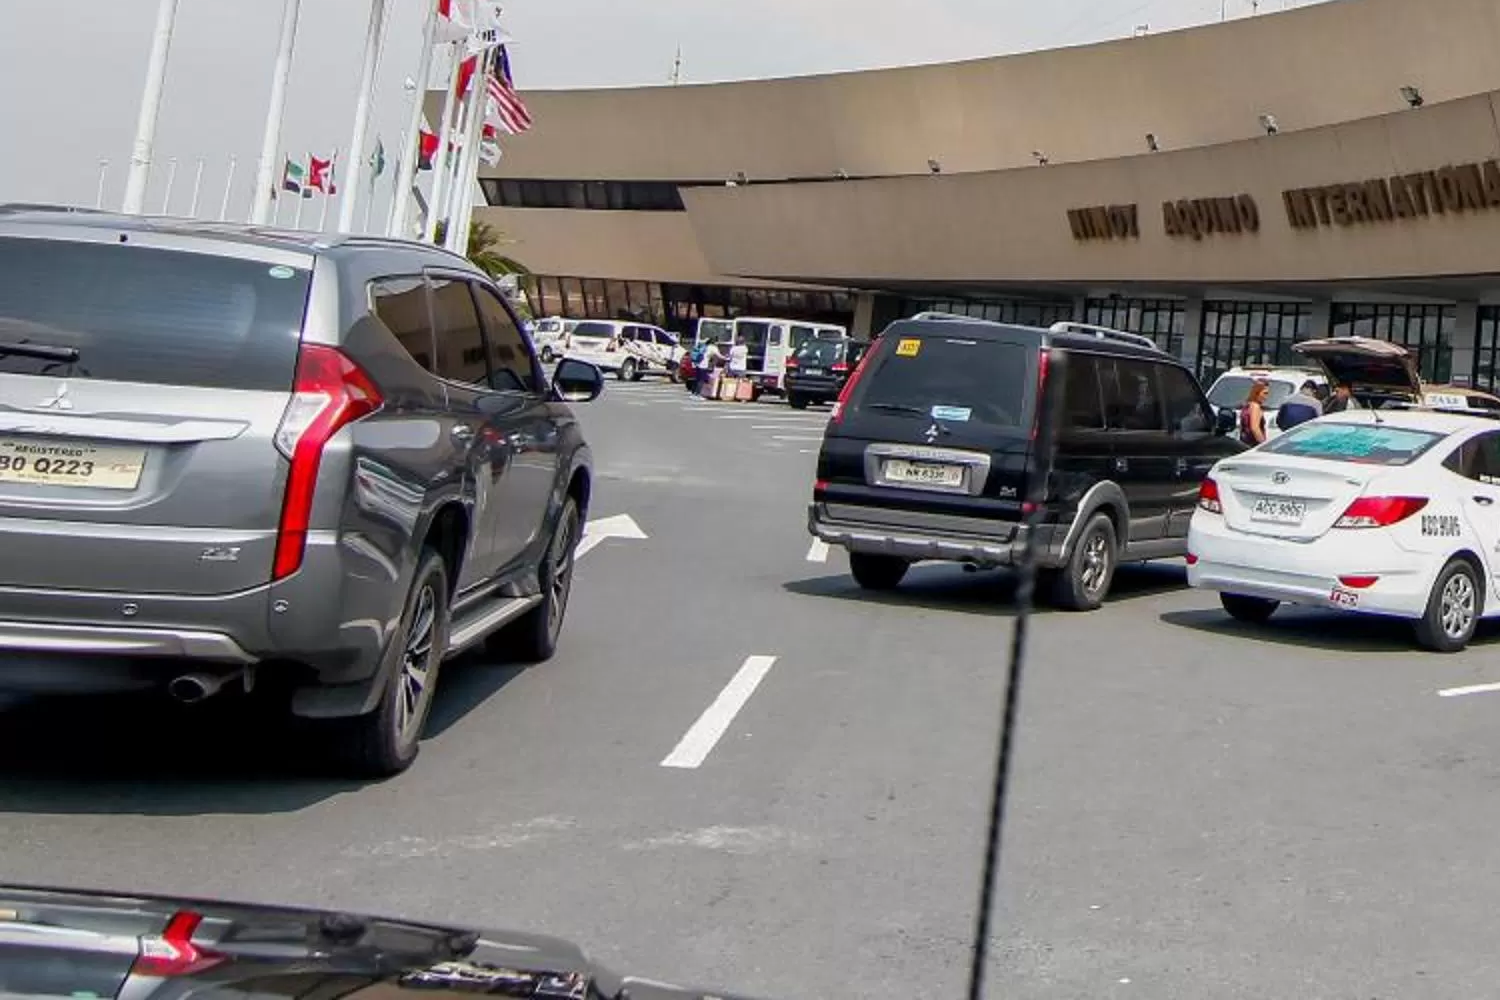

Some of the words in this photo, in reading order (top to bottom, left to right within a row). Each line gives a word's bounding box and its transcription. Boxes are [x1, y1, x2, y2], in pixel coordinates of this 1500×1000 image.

[1067, 203, 1139, 240] NINOY
[1162, 194, 1260, 241] AQUINO
[14, 445, 83, 457] REGISTERED
[33, 457, 94, 476] Q223
